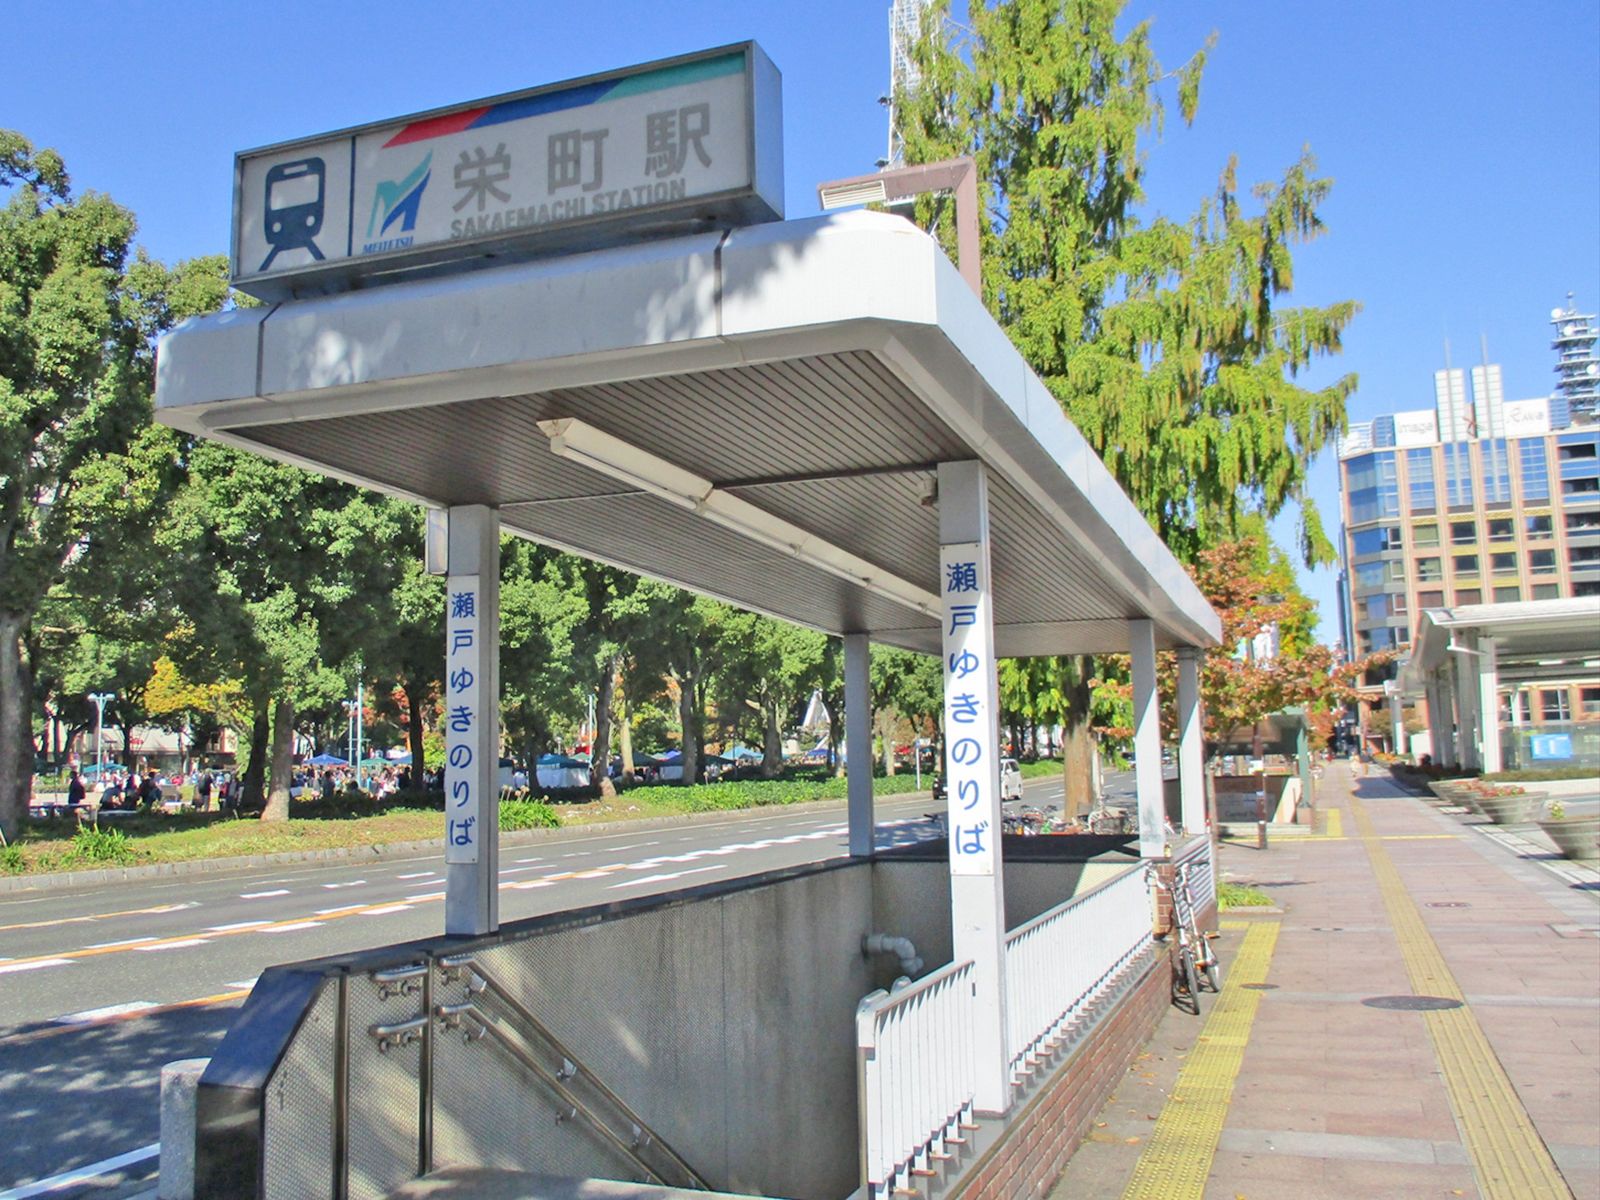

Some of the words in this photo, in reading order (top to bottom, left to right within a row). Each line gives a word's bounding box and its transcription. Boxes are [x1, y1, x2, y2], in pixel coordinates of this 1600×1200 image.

[450, 197, 586, 239] SAKAEMACHI
[592, 178, 687, 215] STATION
[453, 102, 713, 214] 栄町駅
[450, 592, 476, 847] 瀬戸ゆきのりば
[946, 562, 989, 856] 瀬戸ゆきのりば
